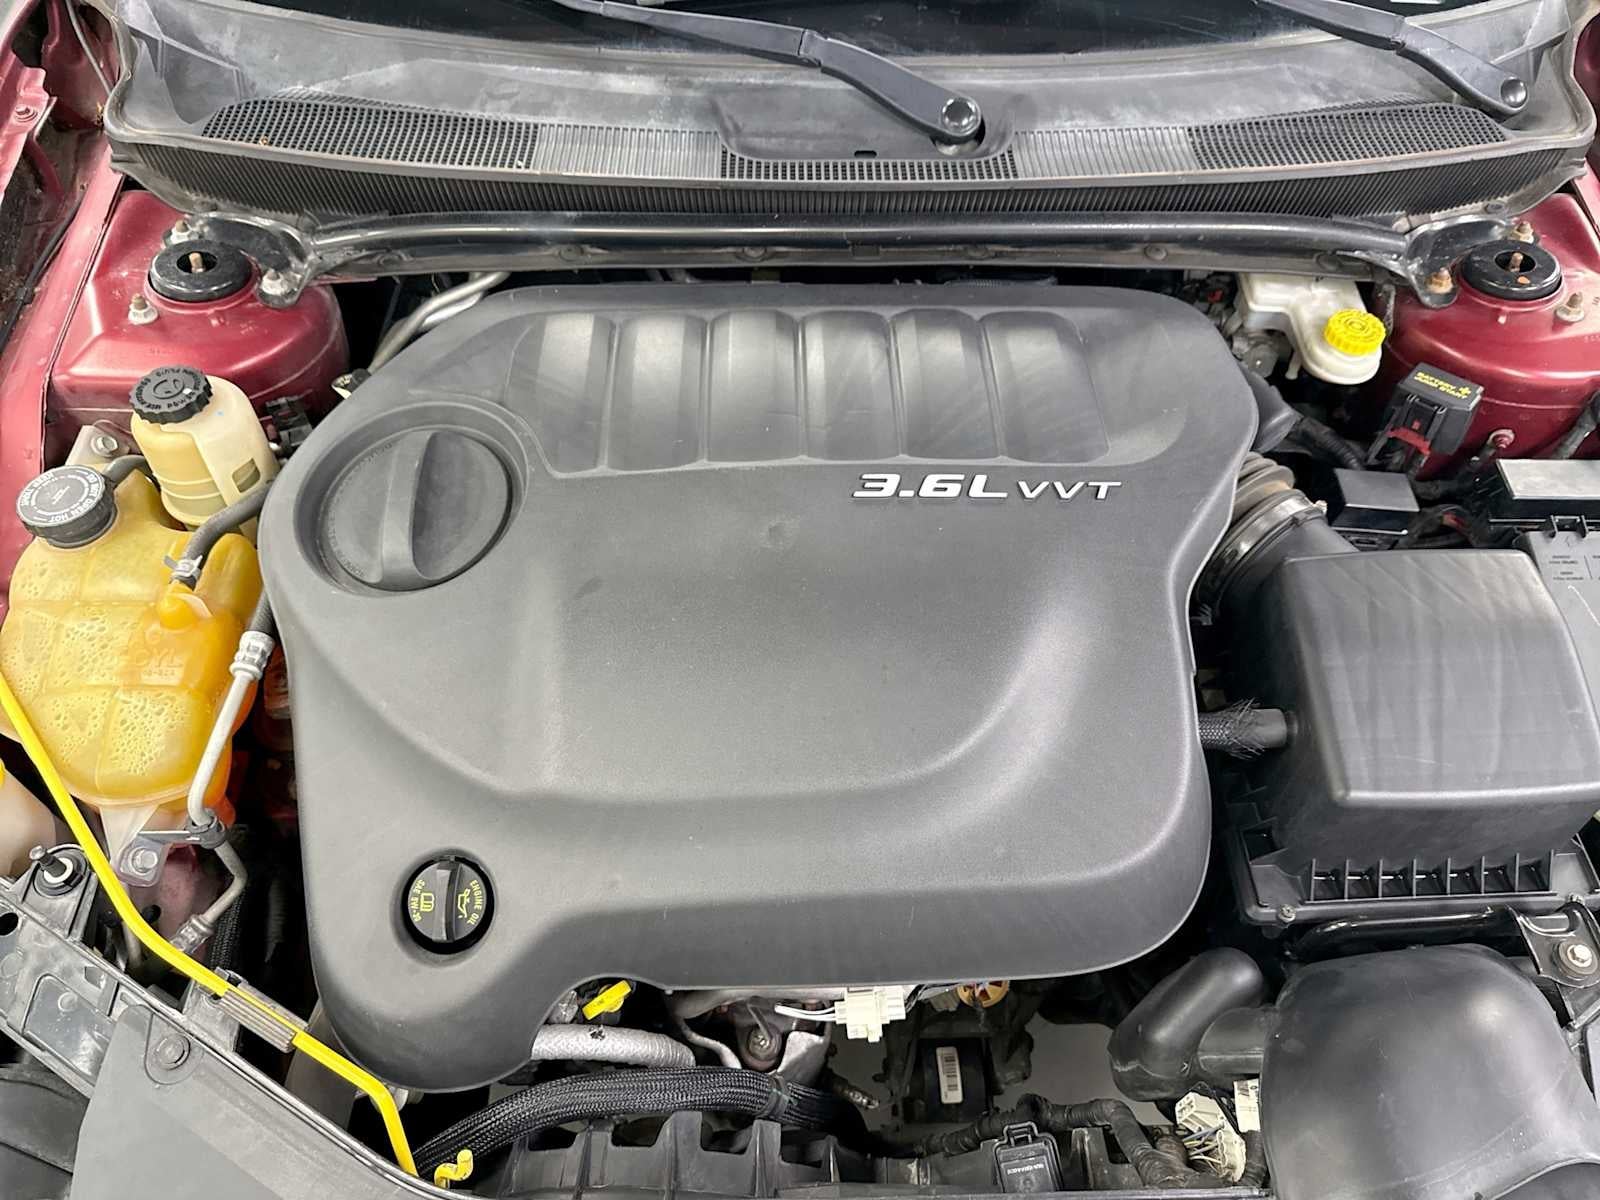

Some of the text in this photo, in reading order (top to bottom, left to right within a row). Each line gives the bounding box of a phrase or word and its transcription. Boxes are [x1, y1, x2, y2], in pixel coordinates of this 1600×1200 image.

[852, 473, 1122, 500] 3.6L VVT
[47, 512, 70, 523] HOT
[466, 880, 484, 925] ENGINE OIL
